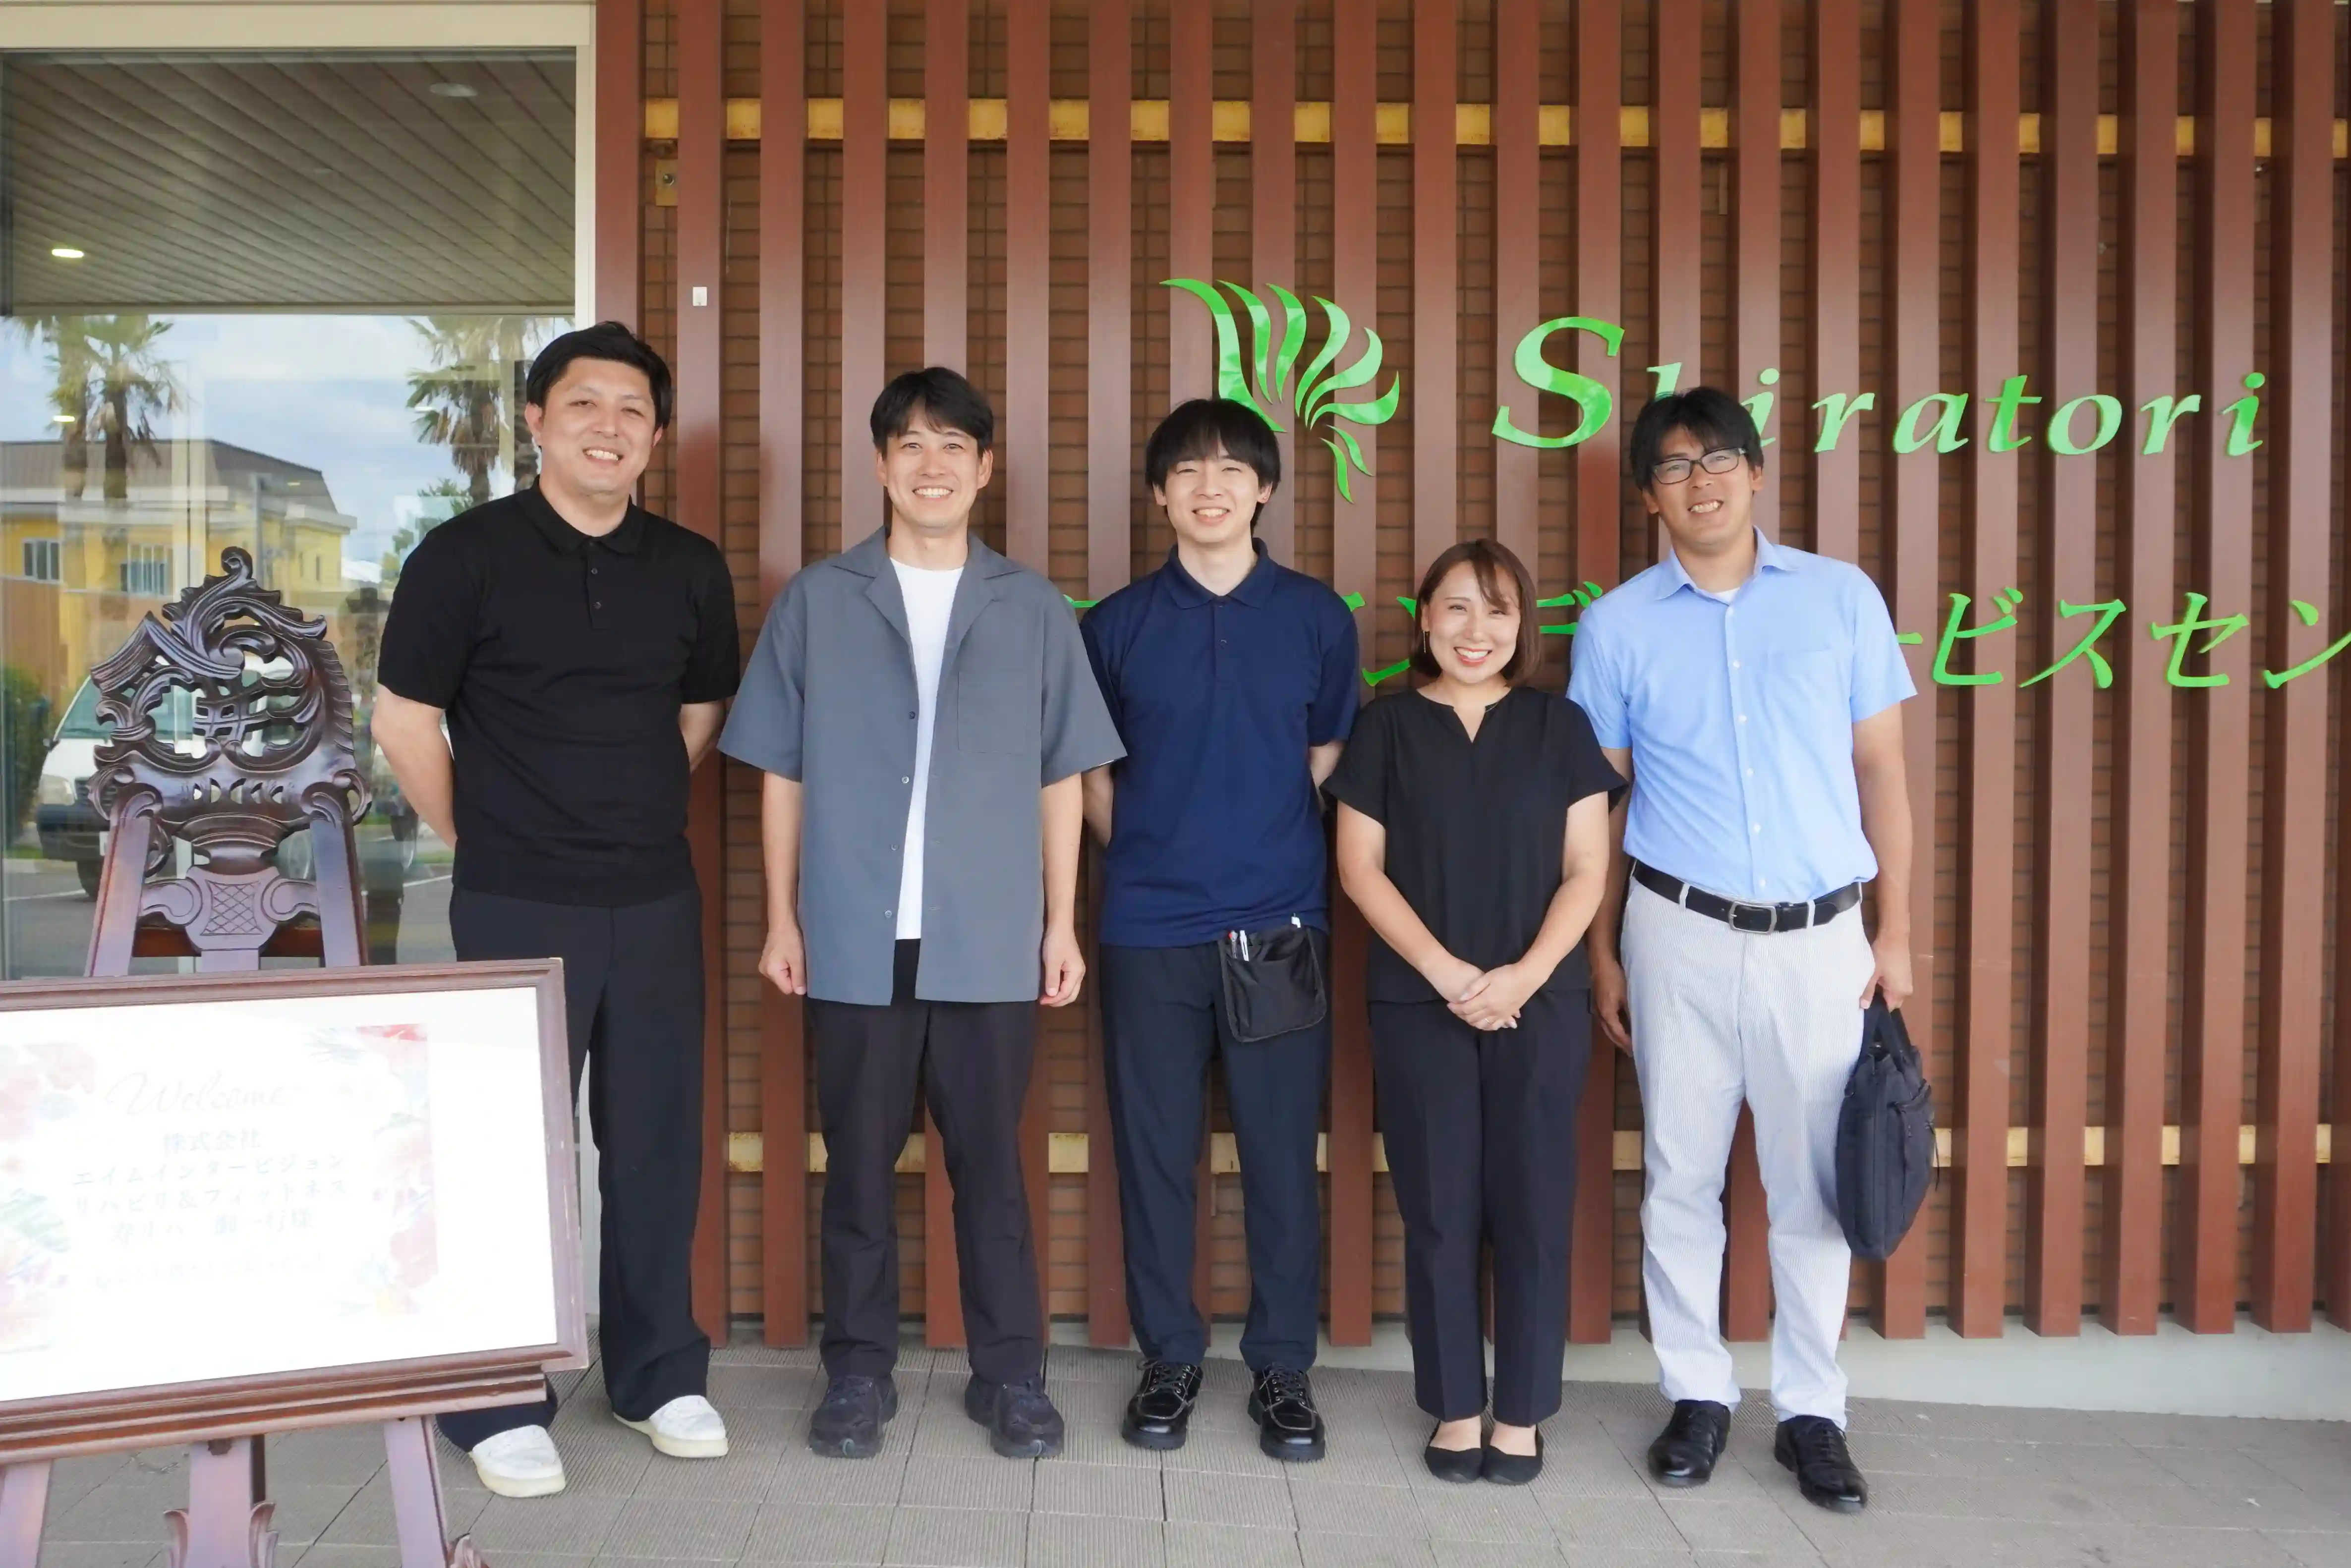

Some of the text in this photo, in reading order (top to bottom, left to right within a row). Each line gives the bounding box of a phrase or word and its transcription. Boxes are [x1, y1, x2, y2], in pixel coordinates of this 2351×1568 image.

[1492, 316, 2265, 455] Siratori
[104, 1069, 302, 1117] Welcome
[162, 1127, 262, 1157] 株式会社
